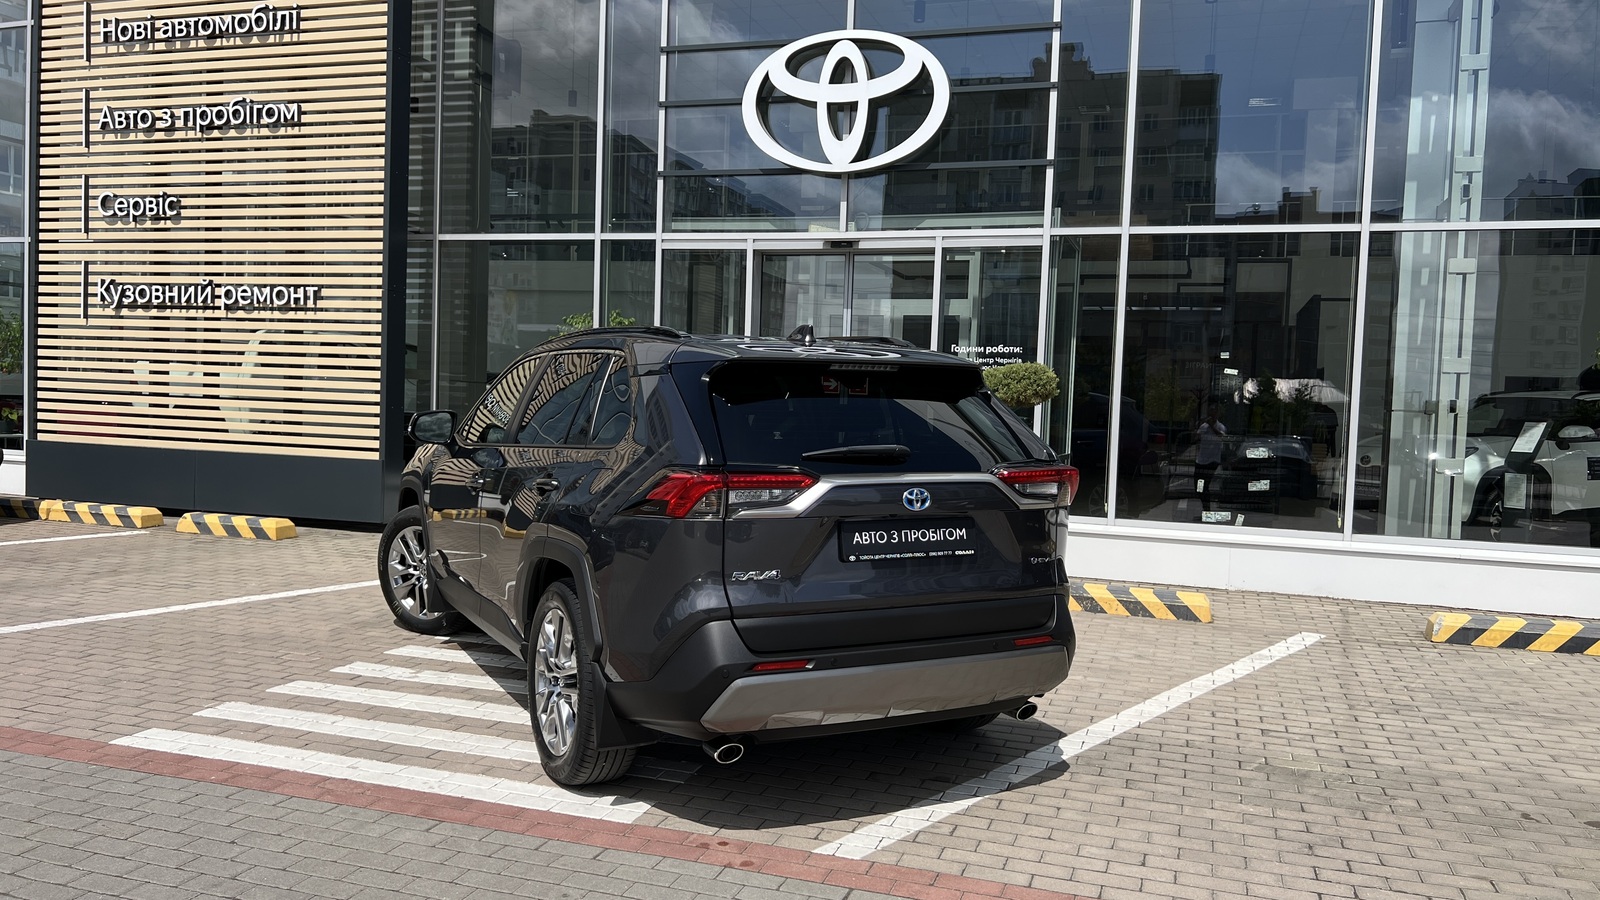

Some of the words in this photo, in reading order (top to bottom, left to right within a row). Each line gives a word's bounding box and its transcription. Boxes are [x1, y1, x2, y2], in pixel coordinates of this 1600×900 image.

[100, 14, 154, 42] Нові
[160, 4, 300, 38] автомобілі
[99, 105, 153, 130] Авто
[160, 107, 172, 128] з
[181, 97, 300, 133] пробігом
[98, 191, 178, 222] Сервіс
[98, 278, 214, 309] Кузовний
[221, 285, 319, 310] ремонт
[951, 344, 984, 353] Години
[986, 344, 1023, 354] роботи:
[974, 357, 994, 365] Центр
[853, 530, 887, 545] АВТО
[890, 530, 899, 543] З
[901, 528, 967, 542] ПРОБІГОМ
[731, 569, 781, 581] RAV4
